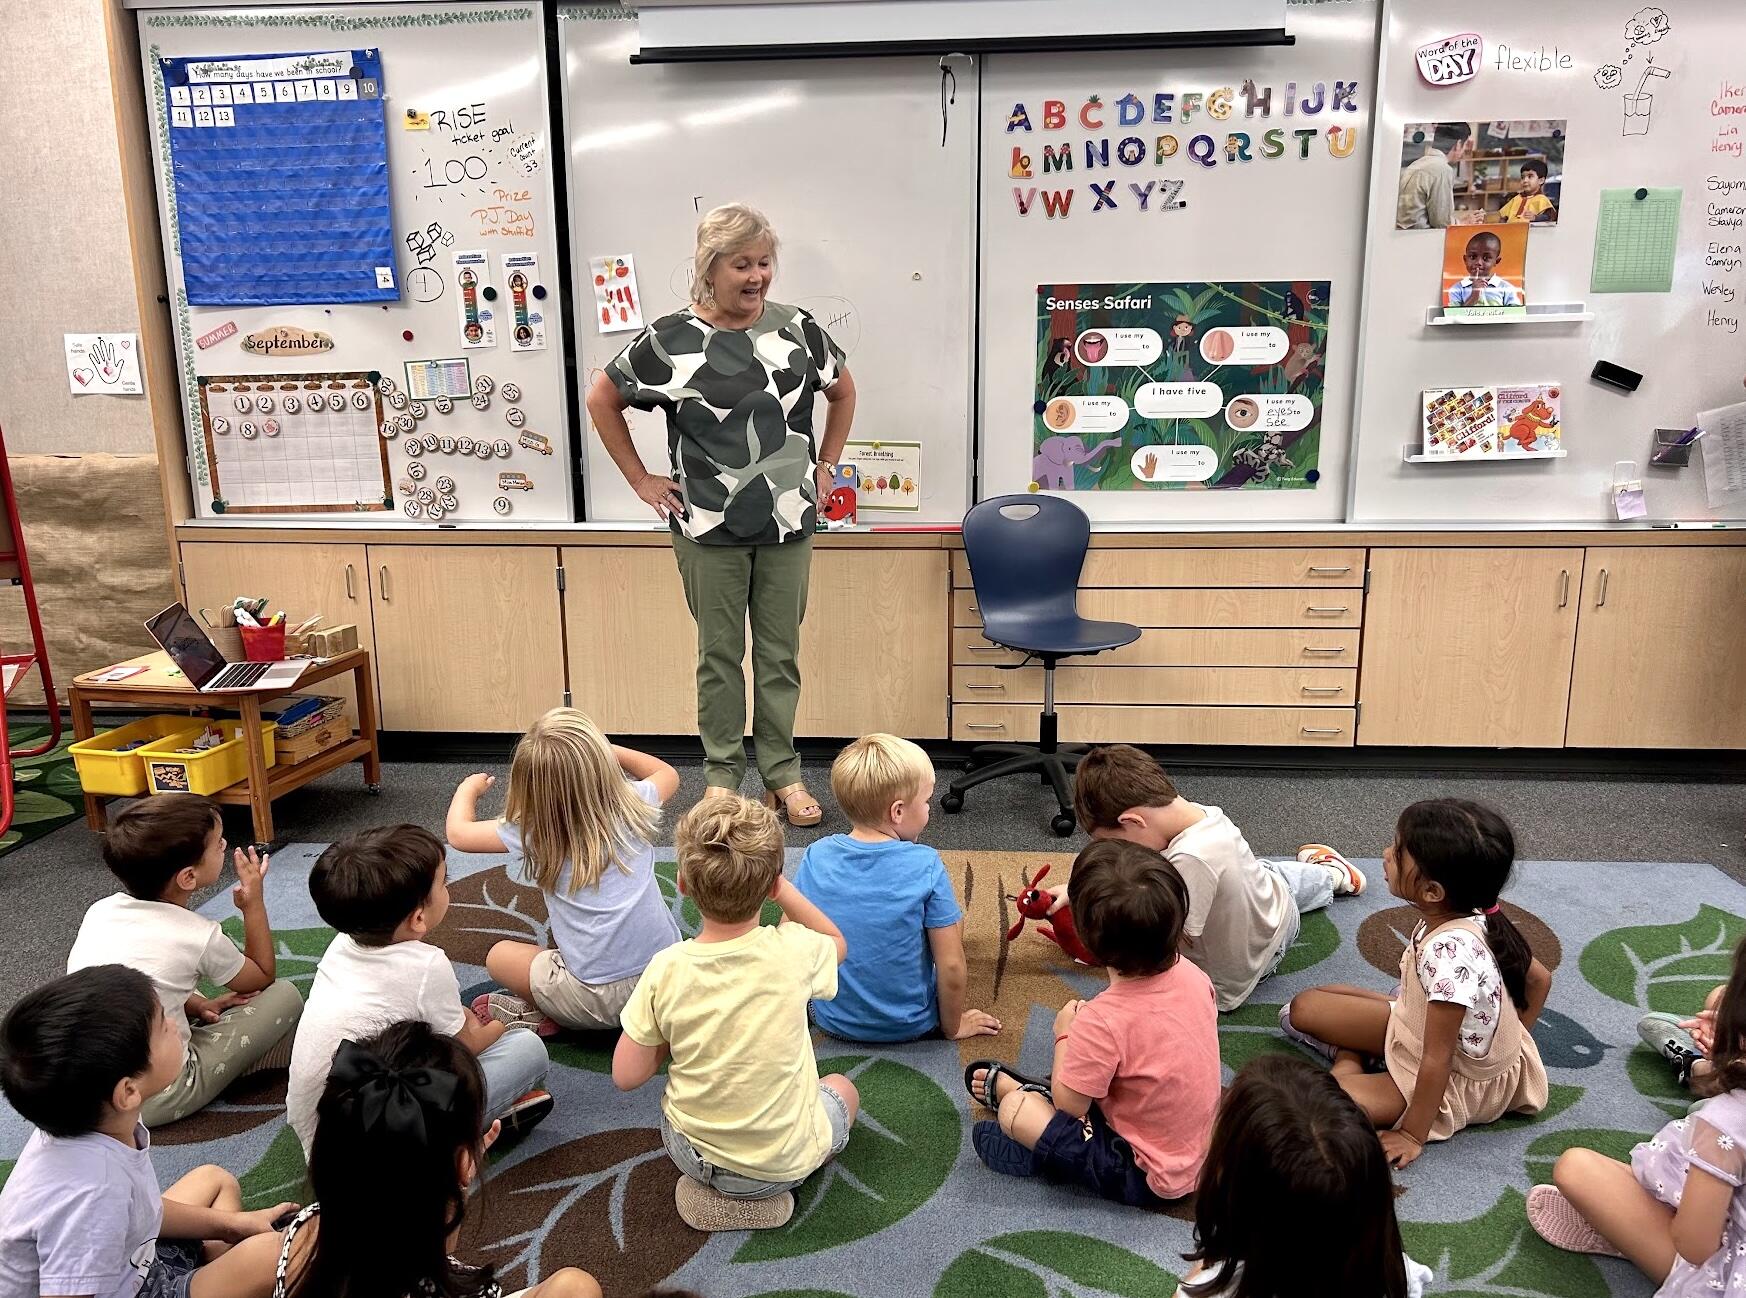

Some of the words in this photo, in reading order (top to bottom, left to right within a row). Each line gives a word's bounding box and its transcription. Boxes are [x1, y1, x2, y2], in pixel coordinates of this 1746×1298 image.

[1418, 45, 1445, 58] Word
[1448, 41, 1458, 51] of
[1462, 38, 1478, 48] the
[1427, 48, 1476, 82] DAY
[1493, 44, 1573, 72] flexible
[214, 72, 233, 80] many
[236, 71, 253, 80] days
[256, 69, 273, 78] have
[287, 68, 303, 76] been
[315, 65, 342, 75] school?
[178, 91, 182, 100] 1
[199, 90, 205, 99] 2
[219, 89, 225, 99] 3
[239, 88, 246, 98] 4
[261, 87, 267, 97] 5
[282, 87, 288, 96] 6
[302, 85, 308, 95] 7
[323, 85, 330, 94] 8
[343, 84, 350, 94] 9
[363, 82, 375, 93] 10
[1720, 79, 1746, 99] Iker
[1007, 104, 1032, 132] A
[1043, 101, 1066, 129] B
[1079, 100, 1103, 130] C
[1116, 97, 1144, 126] D
[1152, 94, 1174, 123] E
[1181, 94, 1202, 123] F
[1206, 90, 1233, 120] G
[1243, 80, 1272, 117] H
[1285, 83, 1297, 116] I
[1300, 83, 1325, 116] J
[1332, 81, 1358, 112] K
[177, 112, 187, 121] 11
[198, 111, 209, 121] 12
[219, 111, 230, 121] 13
[430, 103, 486, 131] RISE
[452, 132, 486, 146] ticket
[491, 120, 515, 143] goal
[1719, 124, 1738, 136] Lia
[510, 136, 535, 158] Current
[1009, 146, 1033, 178] L
[1043, 144, 1073, 173] M
[1086, 139, 1110, 168] N
[1118, 137, 1145, 166] O
[1154, 135, 1178, 165] P
[1187, 134, 1217, 168] Q
[1225, 133, 1252, 163] R
[1260, 128, 1285, 159] S
[1293, 129, 1317, 159] T
[1328, 126, 1355, 158] U
[1711, 138, 1742, 158] Henry
[424, 155, 488, 188] 100
[523, 160, 538, 173] 33
[493, 189, 532, 203] Prize
[1013, 188, 1036, 217] V
[1040, 189, 1074, 219] W
[1089, 180, 1118, 212] X
[1129, 180, 1155, 211] Y
[1159, 180, 1186, 212] Z
[504, 209, 535, 231] Day
[480, 228, 499, 236] with
[1708, 242, 1741, 254] Elena
[1705, 255, 1742, 272] Camryn
[1702, 279, 1735, 302] Wesley
[1046, 297, 1100, 311] Senses
[1104, 295, 1152, 310] Safari
[1707, 309, 1738, 333] Henry
[199, 324, 236, 349] SUMMER
[247, 334, 325, 354] September
[381, 380, 392, 393] 26
[478, 378, 490, 391] 31
[504, 384, 518, 399] 25
[1159, 386, 1184, 396] have
[1187, 386, 1207, 396] five
[239, 397, 245, 409] 1
[261, 397, 269, 409] 2
[288, 398, 295, 410] 3
[311, 396, 319, 407] 4
[333, 395, 340, 407] 5
[357, 394, 365, 407] 6
[392, 395, 404, 404] 15
[438, 398, 449, 411] 18
[473, 396, 486, 406] 24
[412, 403, 423, 416] 20
[1267, 406, 1293, 420] eyes
[400, 418, 413, 428] 30
[509, 411, 521, 423] 17
[217, 419, 225, 430] 7
[245, 423, 252, 435] 8
[382, 424, 394, 434] 19
[1456, 413, 1495, 441] Clifford!
[407, 439, 419, 453] 29
[424, 437, 436, 448] 10
[442, 440, 451, 449] 11
[460, 439, 471, 449] 12
[477, 443, 488, 455] 13
[495, 442, 507, 452] 14
[411, 464, 422, 477] 16
[439, 479, 451, 490] 23
[420, 490, 432, 500] 28
[443, 495, 455, 508] 22
[407, 502, 419, 516] 27
[430, 505, 441, 517] 21
[499, 499, 507, 511] 9
